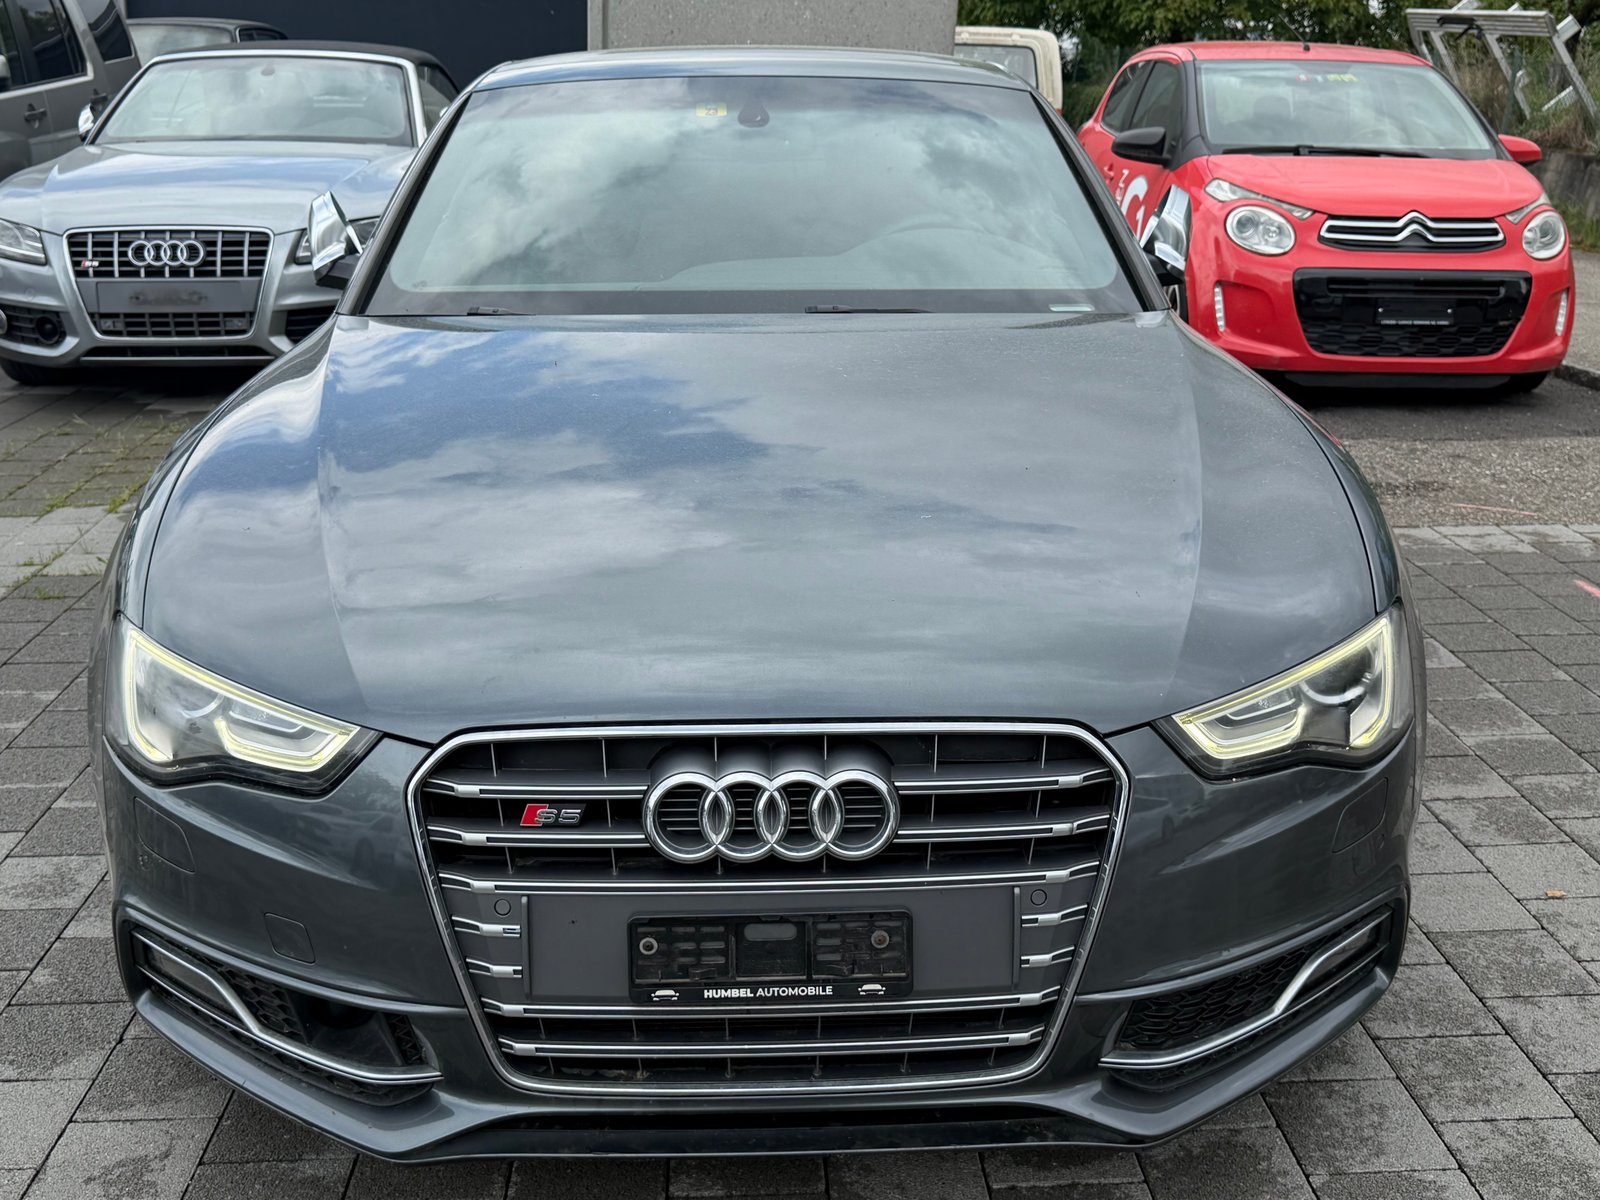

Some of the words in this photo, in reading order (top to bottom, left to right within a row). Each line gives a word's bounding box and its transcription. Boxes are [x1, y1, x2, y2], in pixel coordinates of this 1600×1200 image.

[535, 808, 582, 824] S5
[703, 988, 754, 999] HUMBEL
[756, 986, 833, 997] AUTOMOBILE
